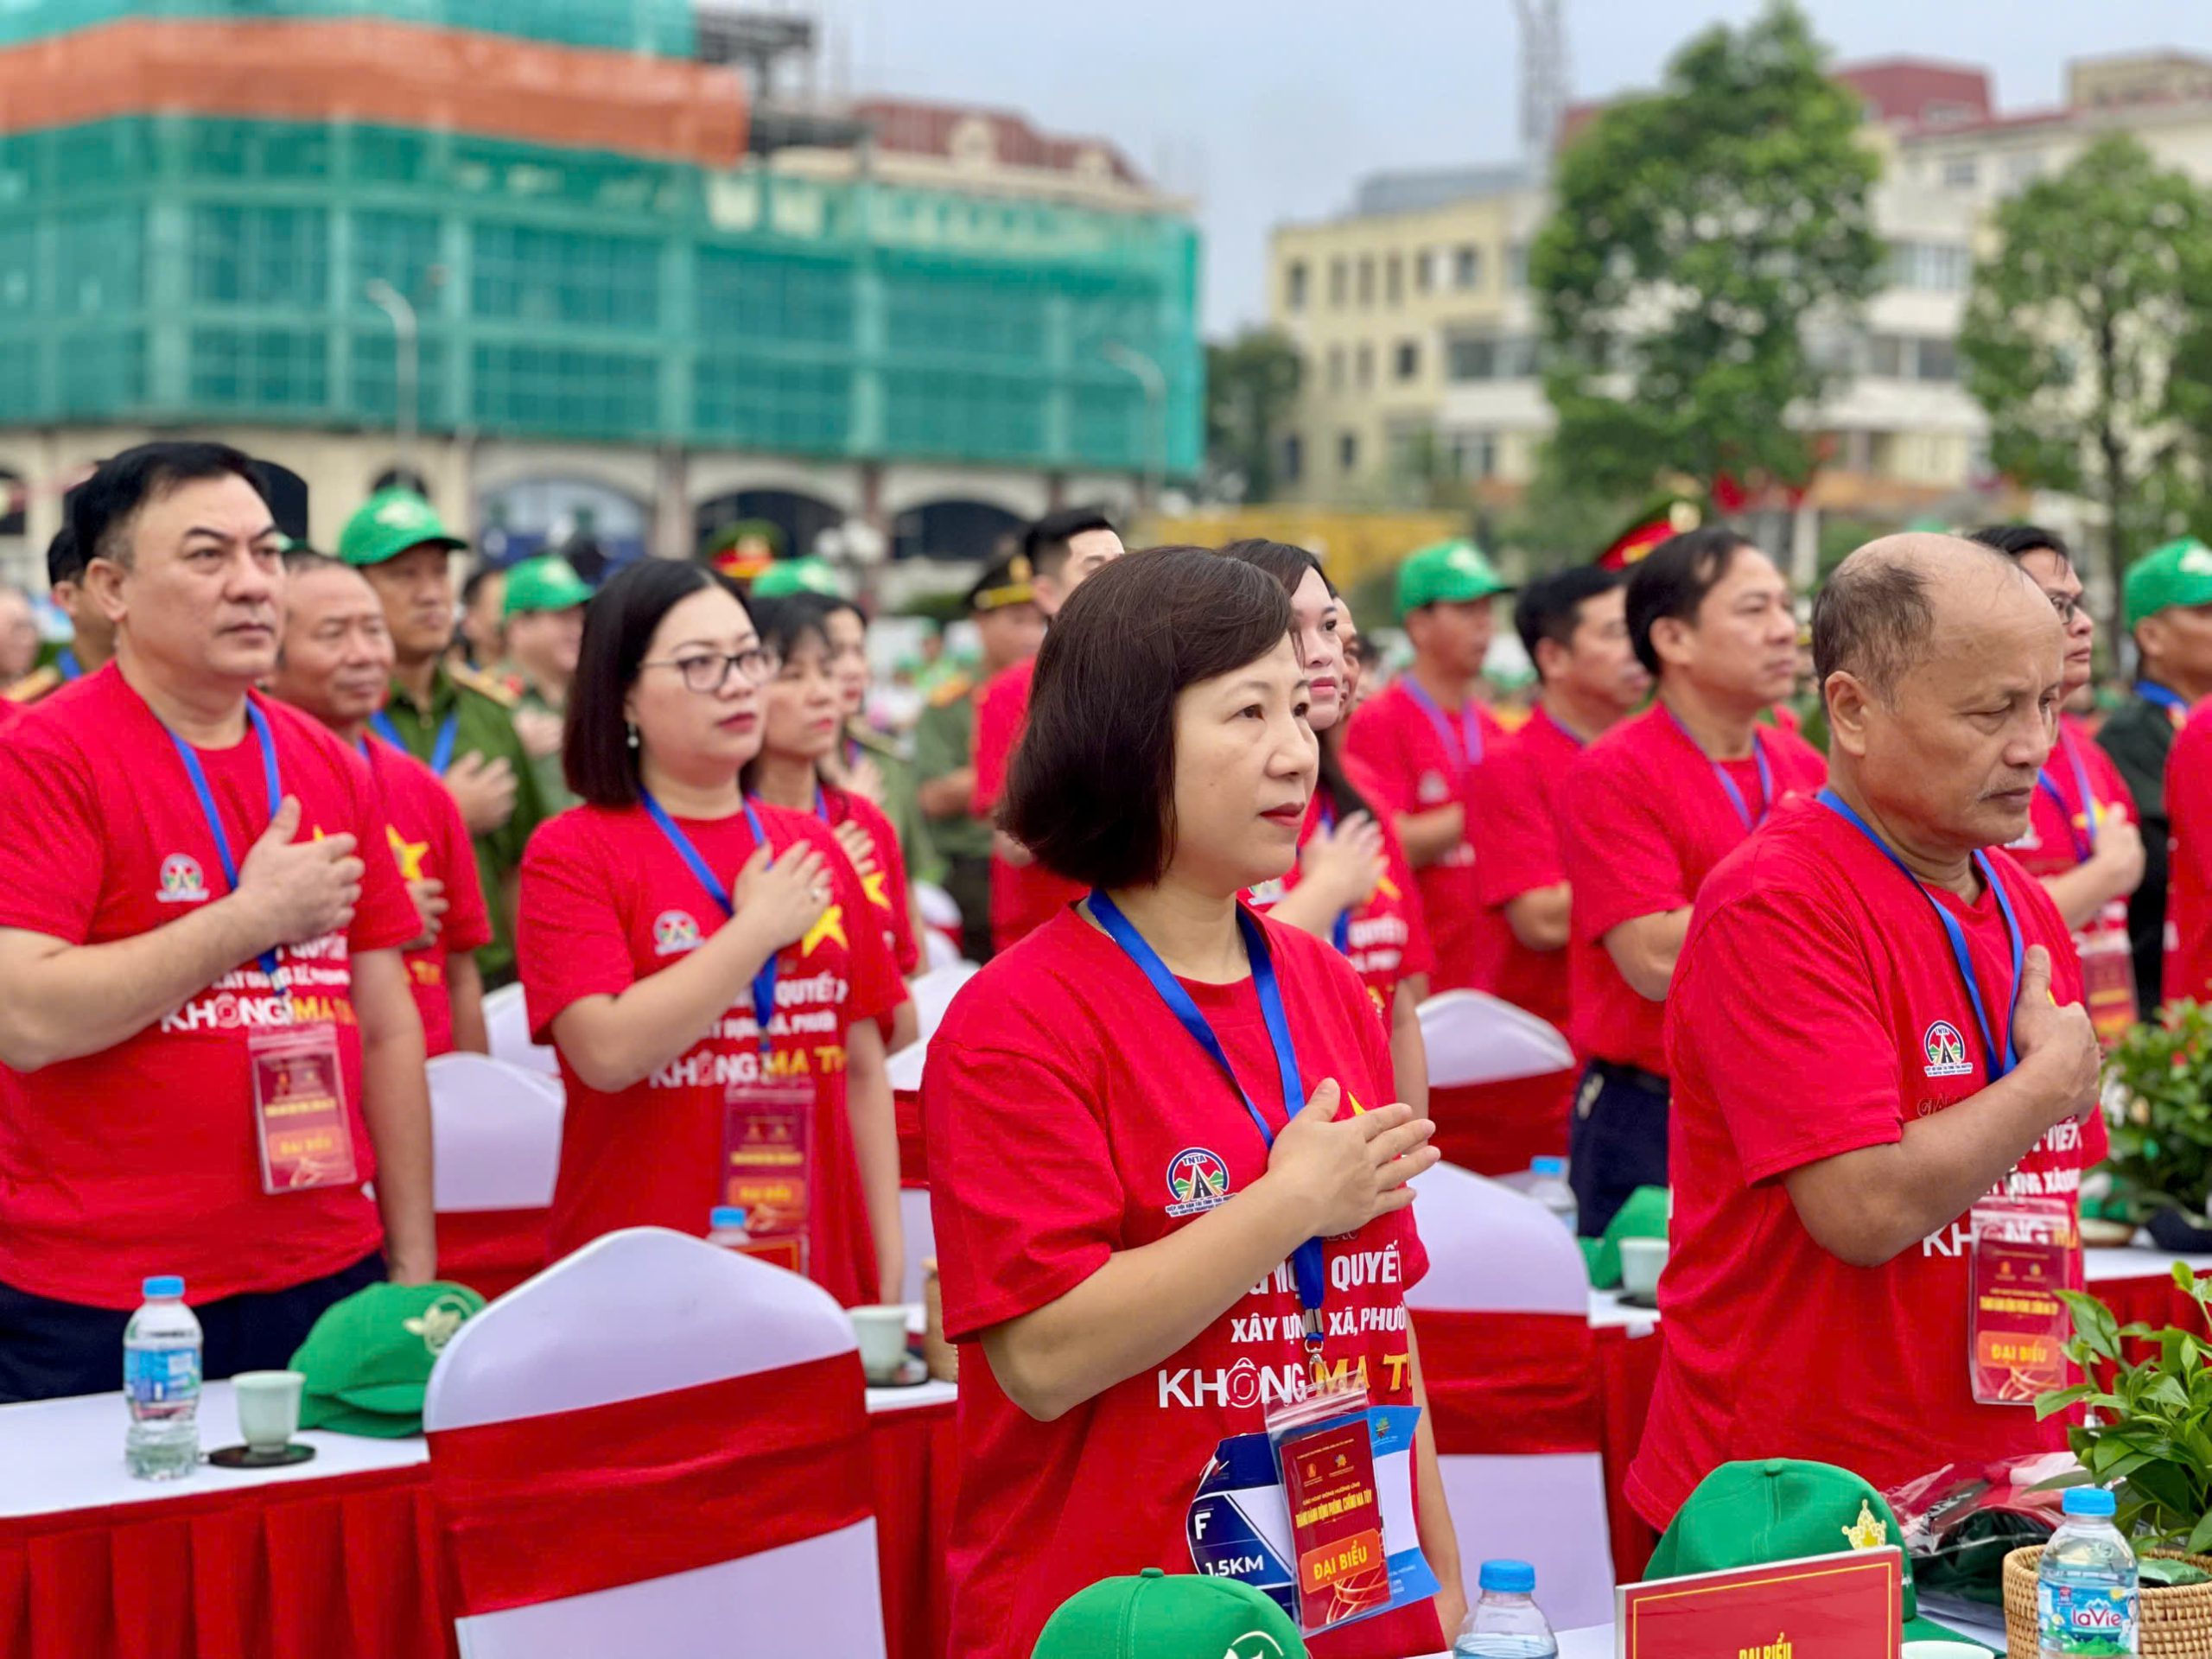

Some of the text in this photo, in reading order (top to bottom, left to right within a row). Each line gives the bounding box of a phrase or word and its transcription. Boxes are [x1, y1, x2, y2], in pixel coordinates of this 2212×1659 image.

[1183, 1155, 1205, 1165] TNTA
[1230, 1313, 1278, 1343] XÂY
[1329, 1306, 1358, 1337] XÃ,
[1158, 1357, 1306, 1409] KHÔNG
[1314, 1355, 1370, 1397] MA
[1194, 1512, 1211, 1540] F
[1205, 1554, 1264, 1577] 1.5KM
[1313, 1559, 1337, 1581] ĐẠI
[1338, 1540, 1368, 1571] BIỂU
[2072, 1608, 2121, 1627] laVie
